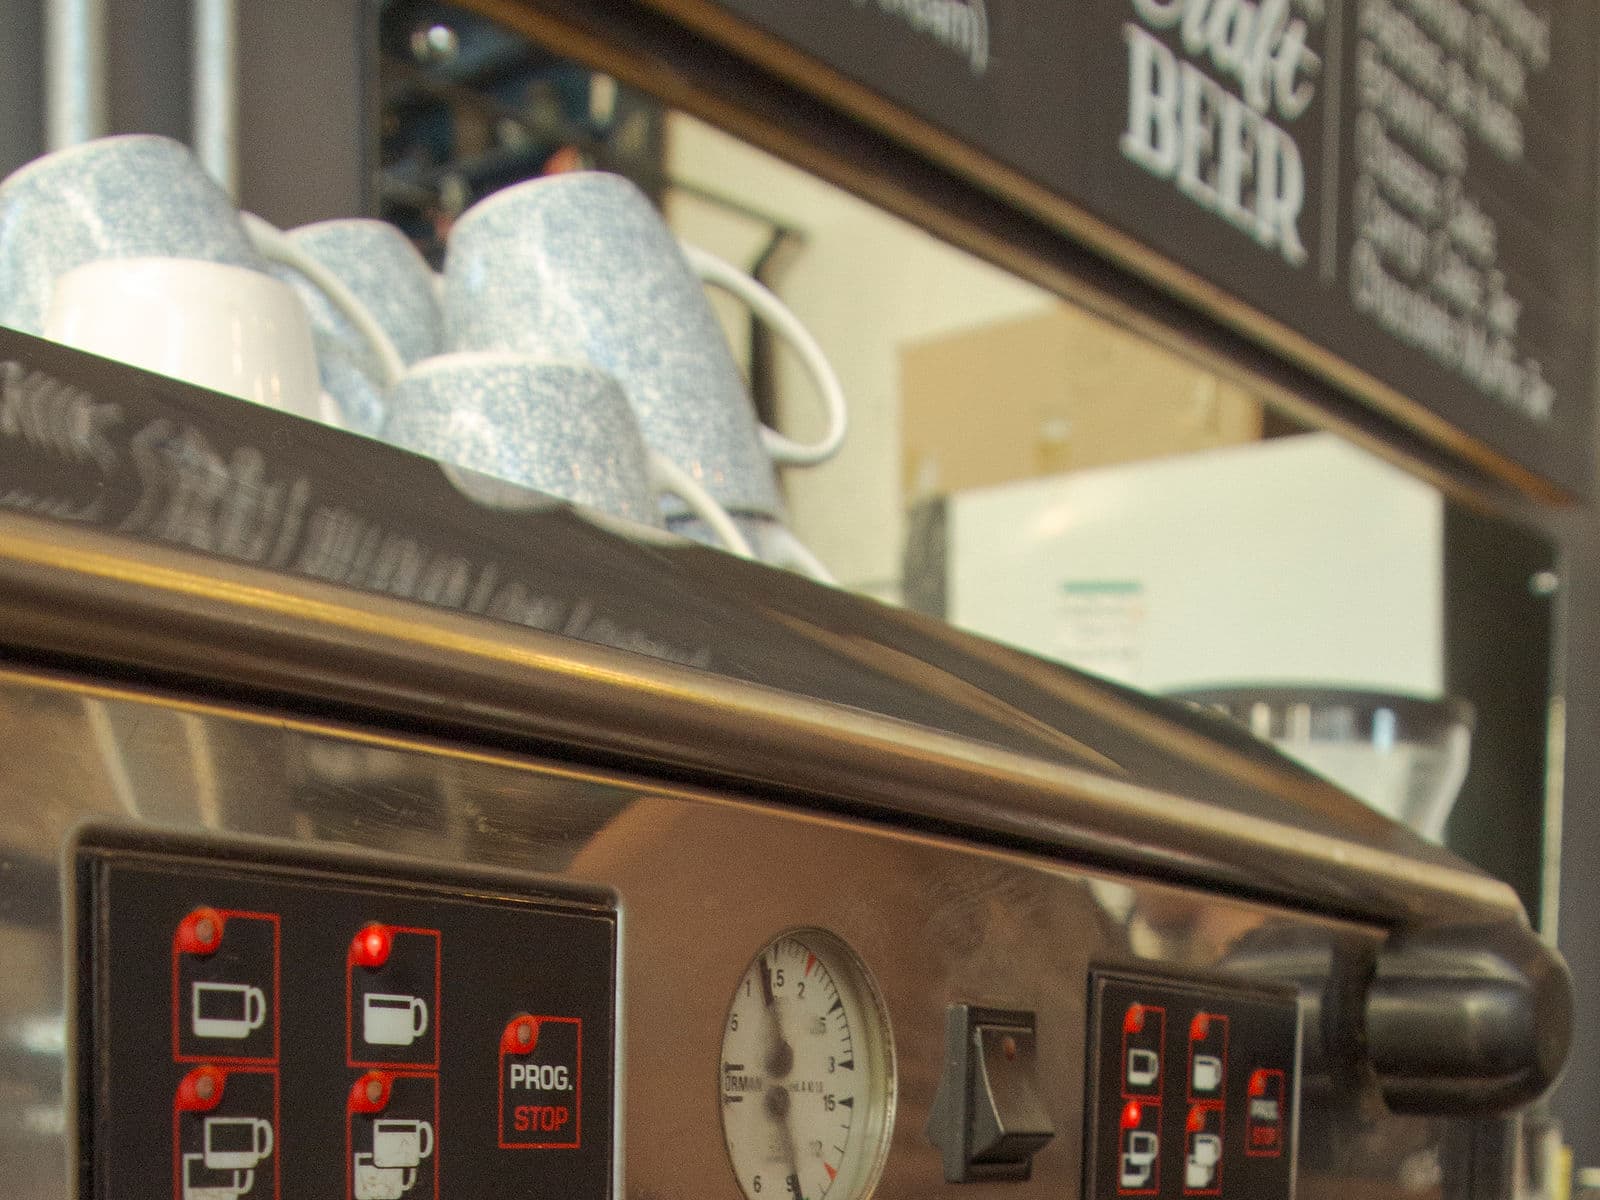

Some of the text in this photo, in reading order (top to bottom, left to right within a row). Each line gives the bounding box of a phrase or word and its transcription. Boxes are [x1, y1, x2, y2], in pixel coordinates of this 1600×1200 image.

[1120, 22, 1308, 264] BEER
[797, 982, 805, 999] 2
[828, 1056, 836, 1074] 3
[510, 1064, 574, 1091] PROG.
[823, 1094, 836, 1112] 15
[514, 1105, 569, 1131] STOP
[753, 1175, 762, 1193] 6
